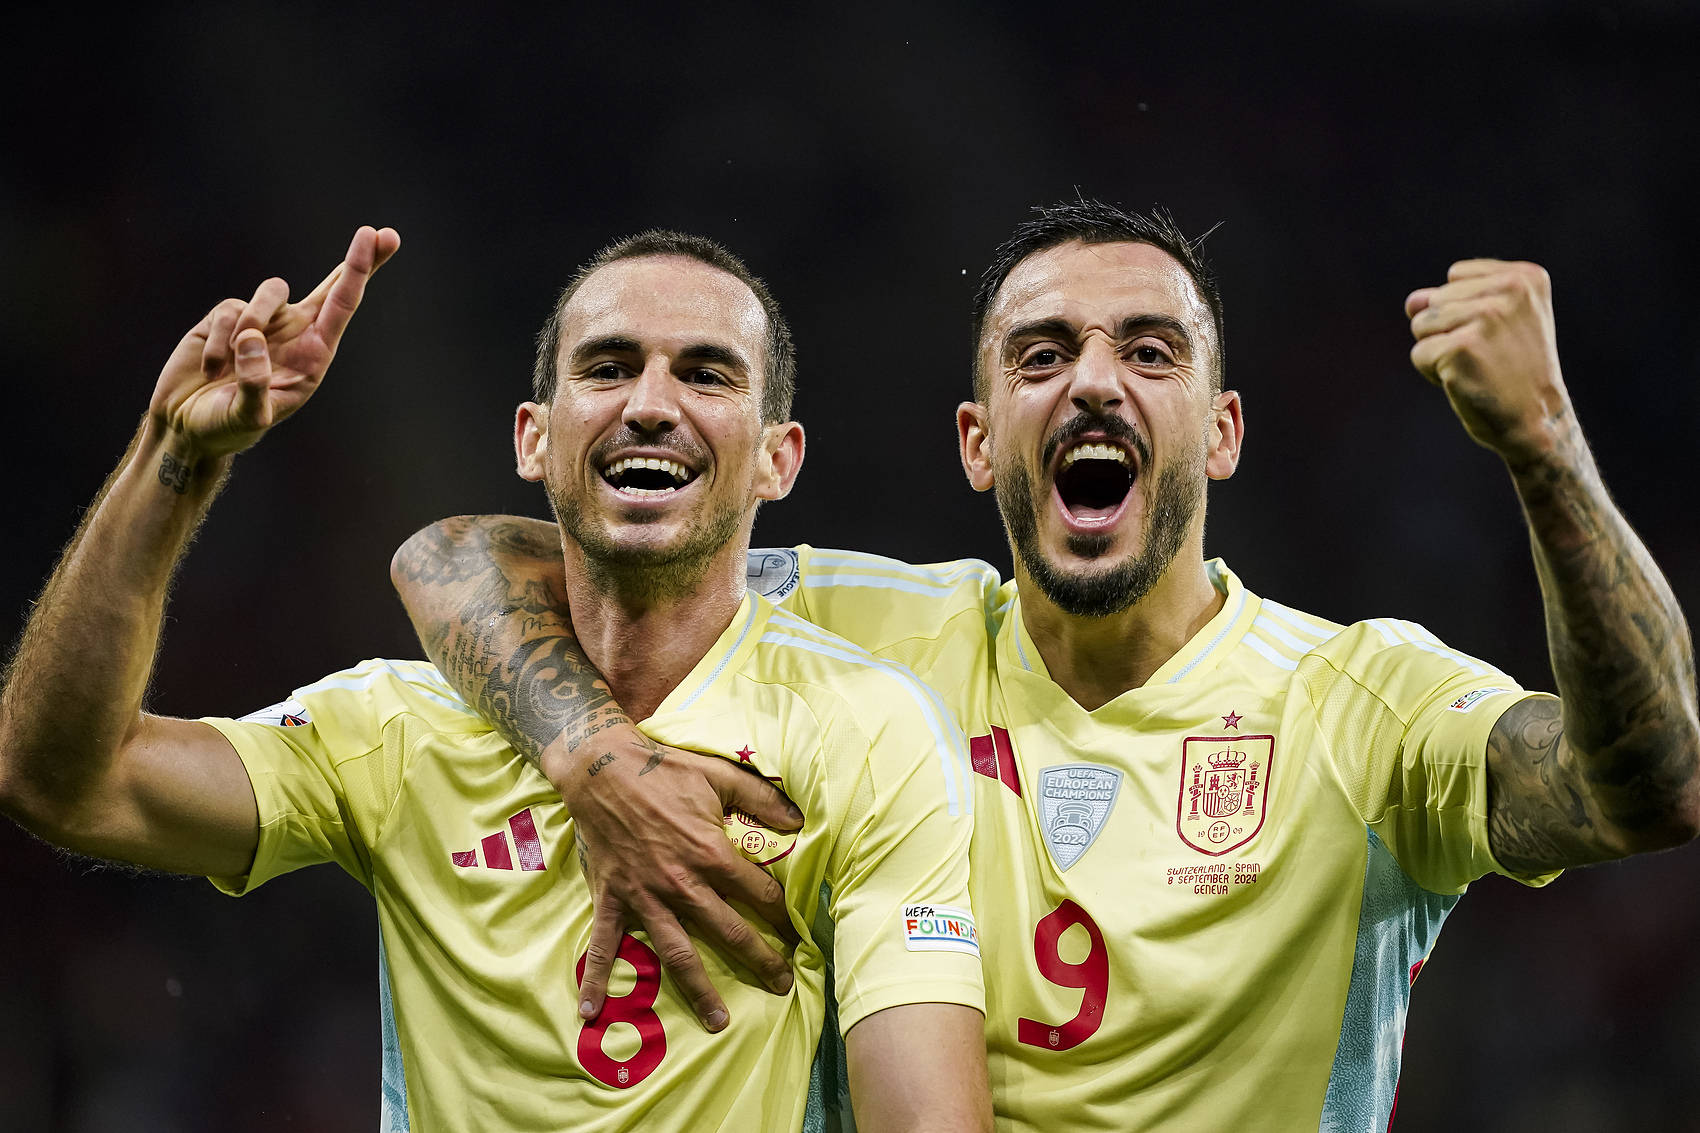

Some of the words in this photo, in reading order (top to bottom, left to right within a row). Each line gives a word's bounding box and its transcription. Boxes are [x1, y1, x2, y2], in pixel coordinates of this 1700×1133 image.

[1069, 769, 1096, 779] UEFA
[1046, 777, 1113, 790] EUROPEAN
[1045, 788, 1113, 800] CHAMPIONS
[1053, 833, 1087, 846] 2024
[1166, 863, 1226, 876] SWITZERLAND
[1235, 863, 1261, 873] SPAIN
[1167, 876, 1174, 885] 8
[1177, 873, 1230, 885] SEPTEMBER
[1234, 873, 1257, 885] 2024
[1193, 884, 1229, 895] GENEVA
[905, 906, 935, 917] UEFA
[1018, 898, 1110, 1052] 9
[575, 931, 667, 1089] 8
